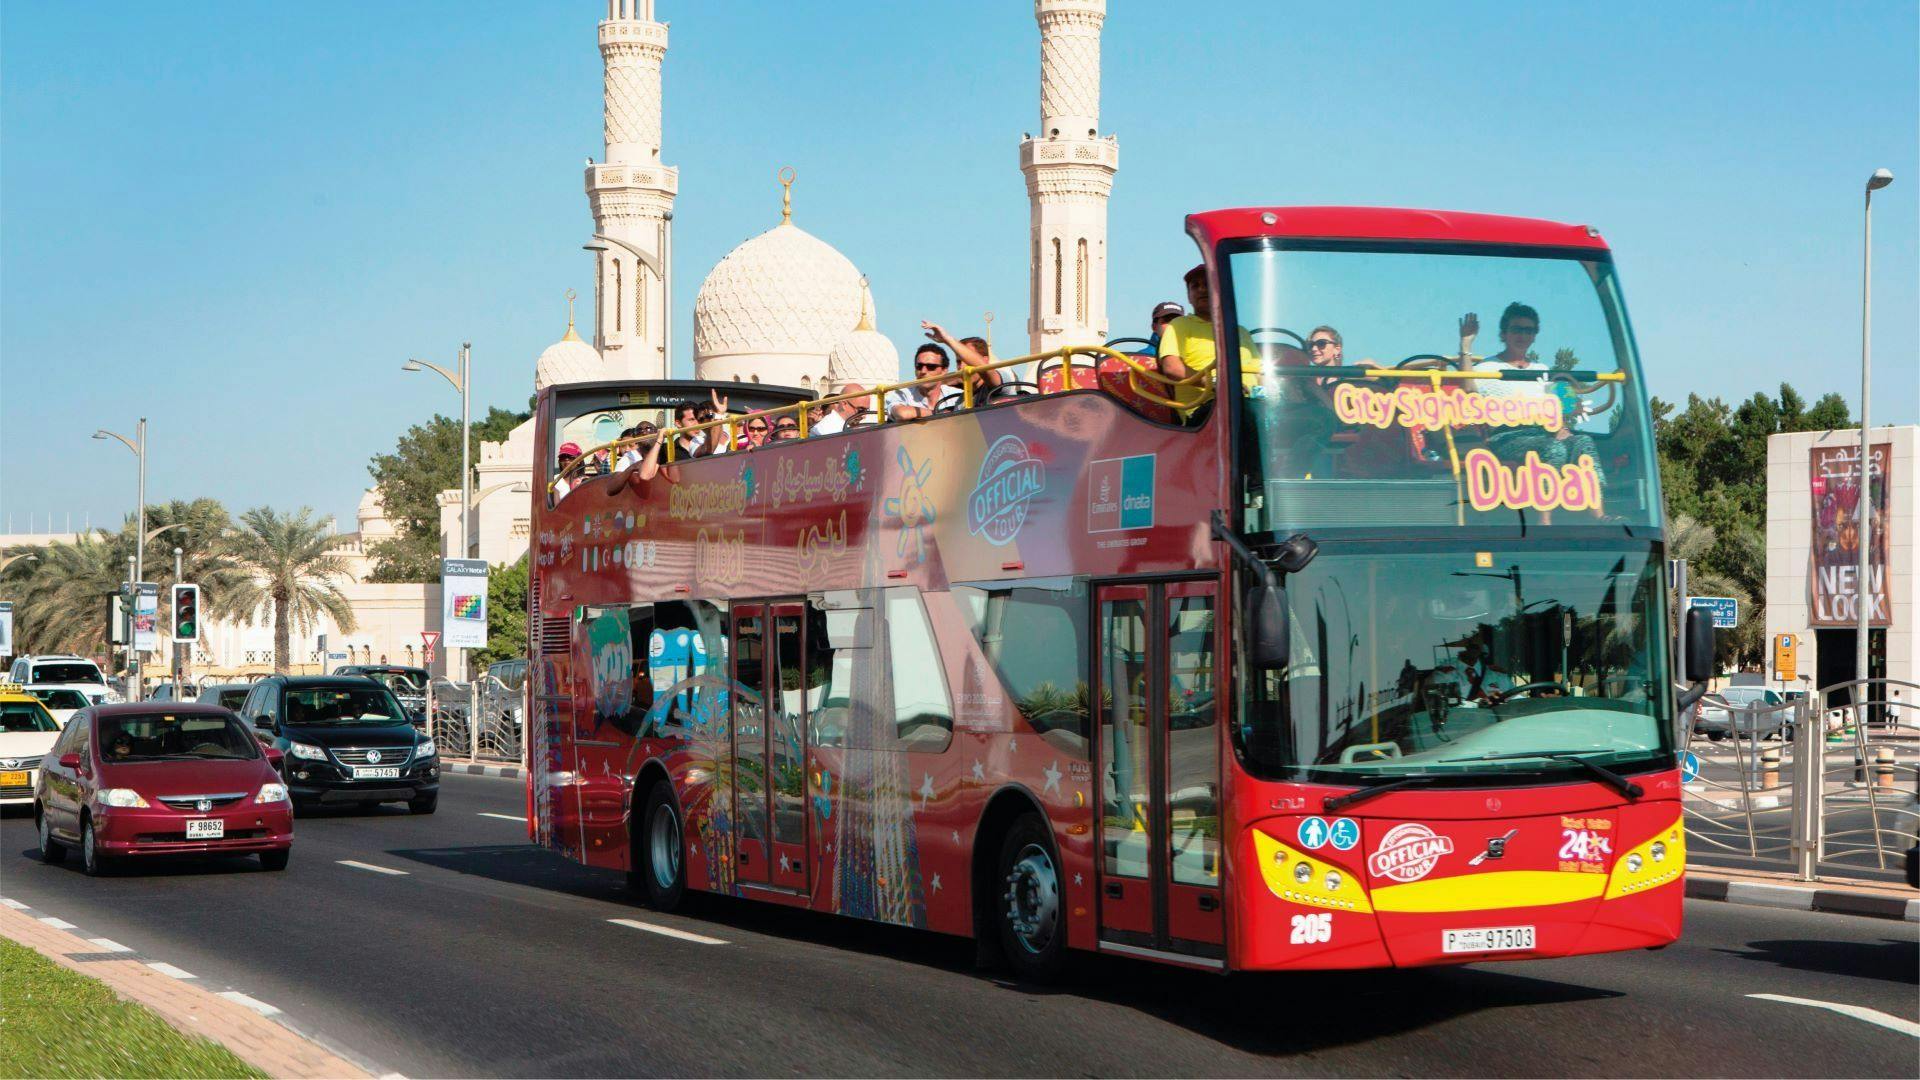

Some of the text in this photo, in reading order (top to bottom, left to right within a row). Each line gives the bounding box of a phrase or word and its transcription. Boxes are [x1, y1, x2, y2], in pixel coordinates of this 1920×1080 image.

[975, 465, 1041, 523] OFFICIAL
[1465, 448, 1601, 511] Dubai
[1124, 494, 1150, 510] dnata
[994, 505, 1024, 537] TOUR
[696, 528, 744, 583] Dubai
[374, 769, 398, 777] 57457
[198, 821, 222, 831] 98652
[1377, 839, 1449, 871] OFFICIAL
[1400, 859, 1431, 877] TOUR
[1290, 913, 1332, 945] 205
[1449, 929, 1532, 950] P 97503
